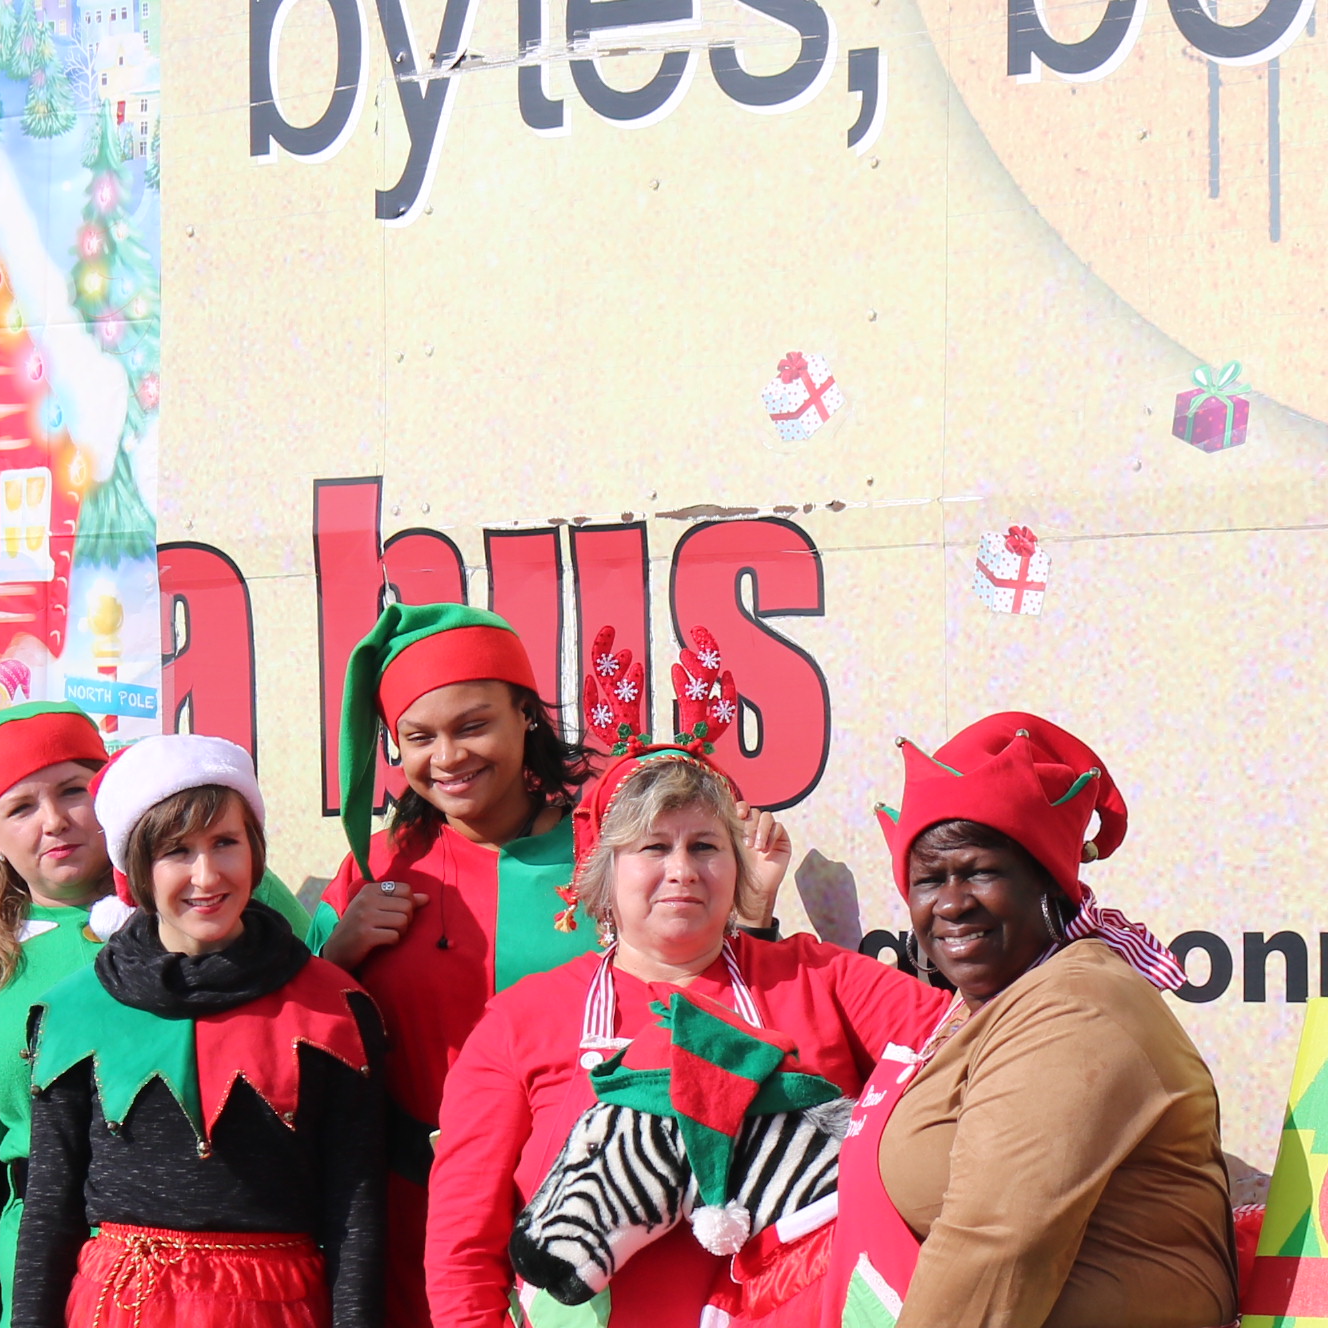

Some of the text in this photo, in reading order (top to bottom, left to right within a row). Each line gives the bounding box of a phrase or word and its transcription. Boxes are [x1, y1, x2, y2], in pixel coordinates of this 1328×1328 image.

[249, 0, 888, 228] bytes,
[67, 684, 155, 710] NORTH POLE
[312, 474, 831, 818] bus
